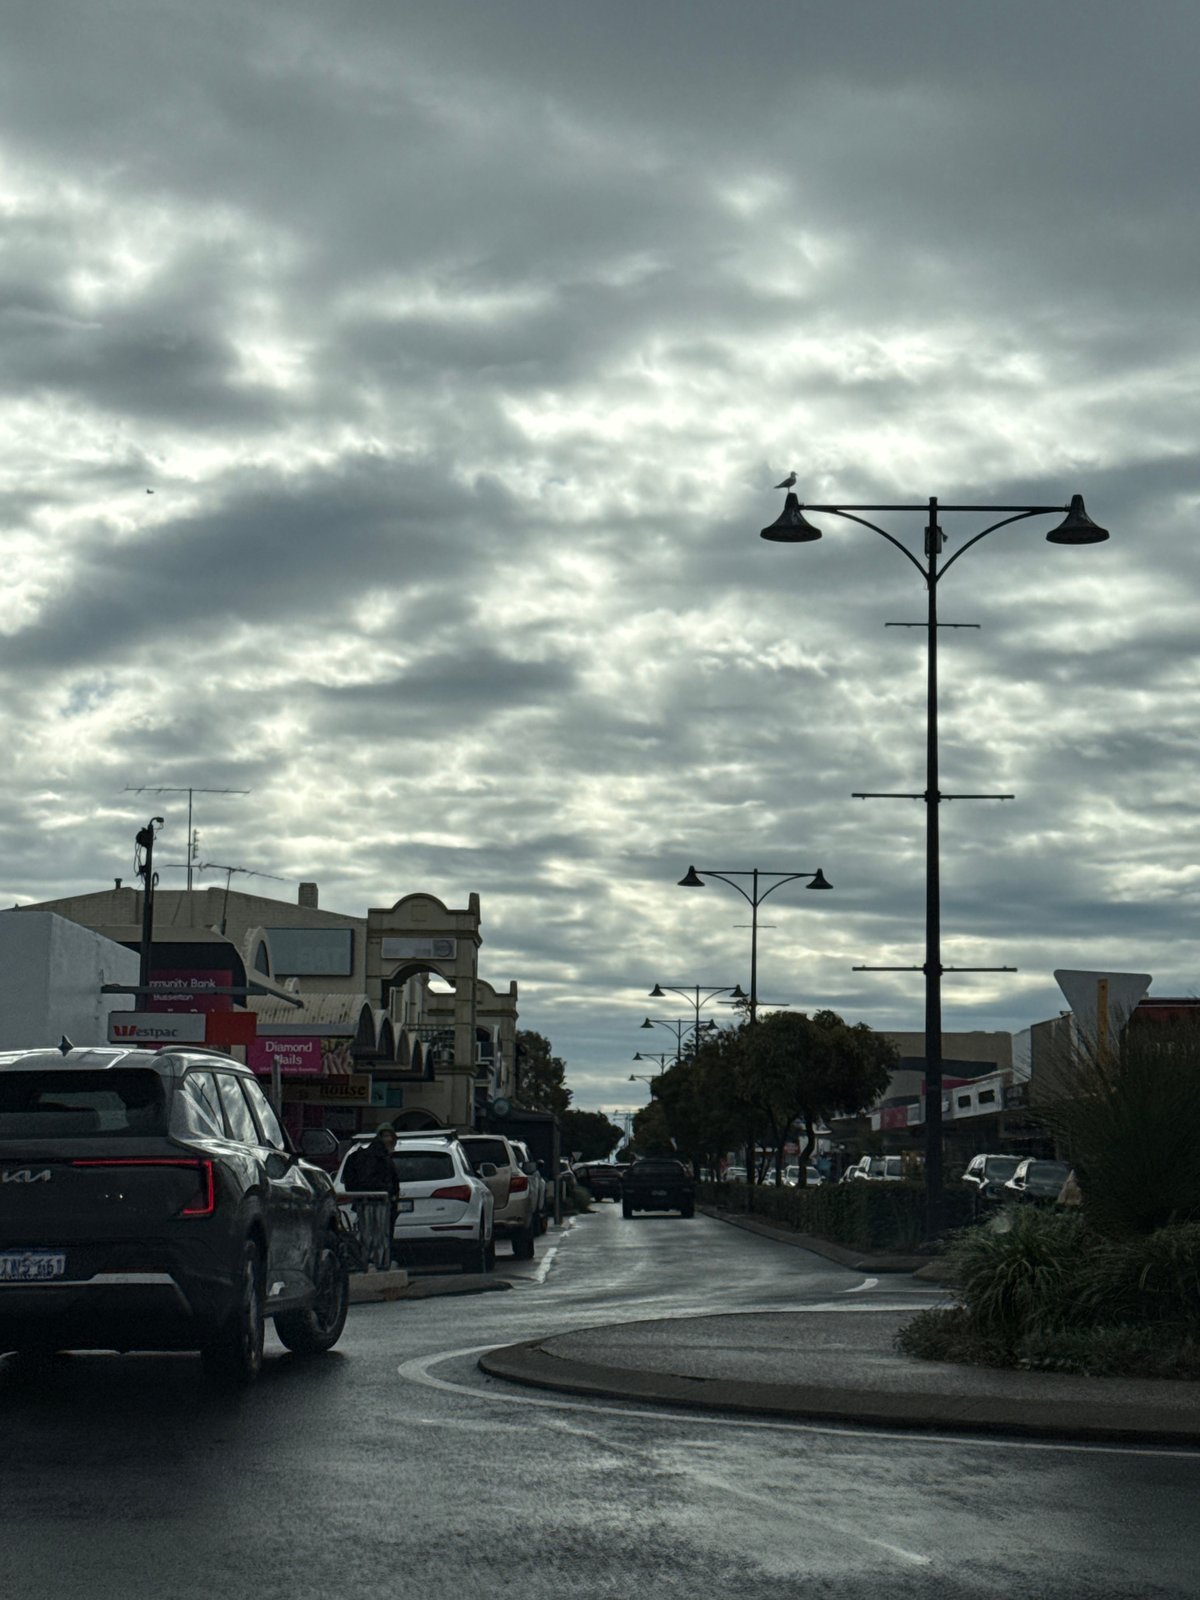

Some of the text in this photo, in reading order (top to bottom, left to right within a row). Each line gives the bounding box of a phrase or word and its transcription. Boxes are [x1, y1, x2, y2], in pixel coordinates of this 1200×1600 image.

[190, 978, 216, 988] Bank
[113, 1025, 179, 1039] Westpac
[265, 1040, 313, 1053] Diamond
